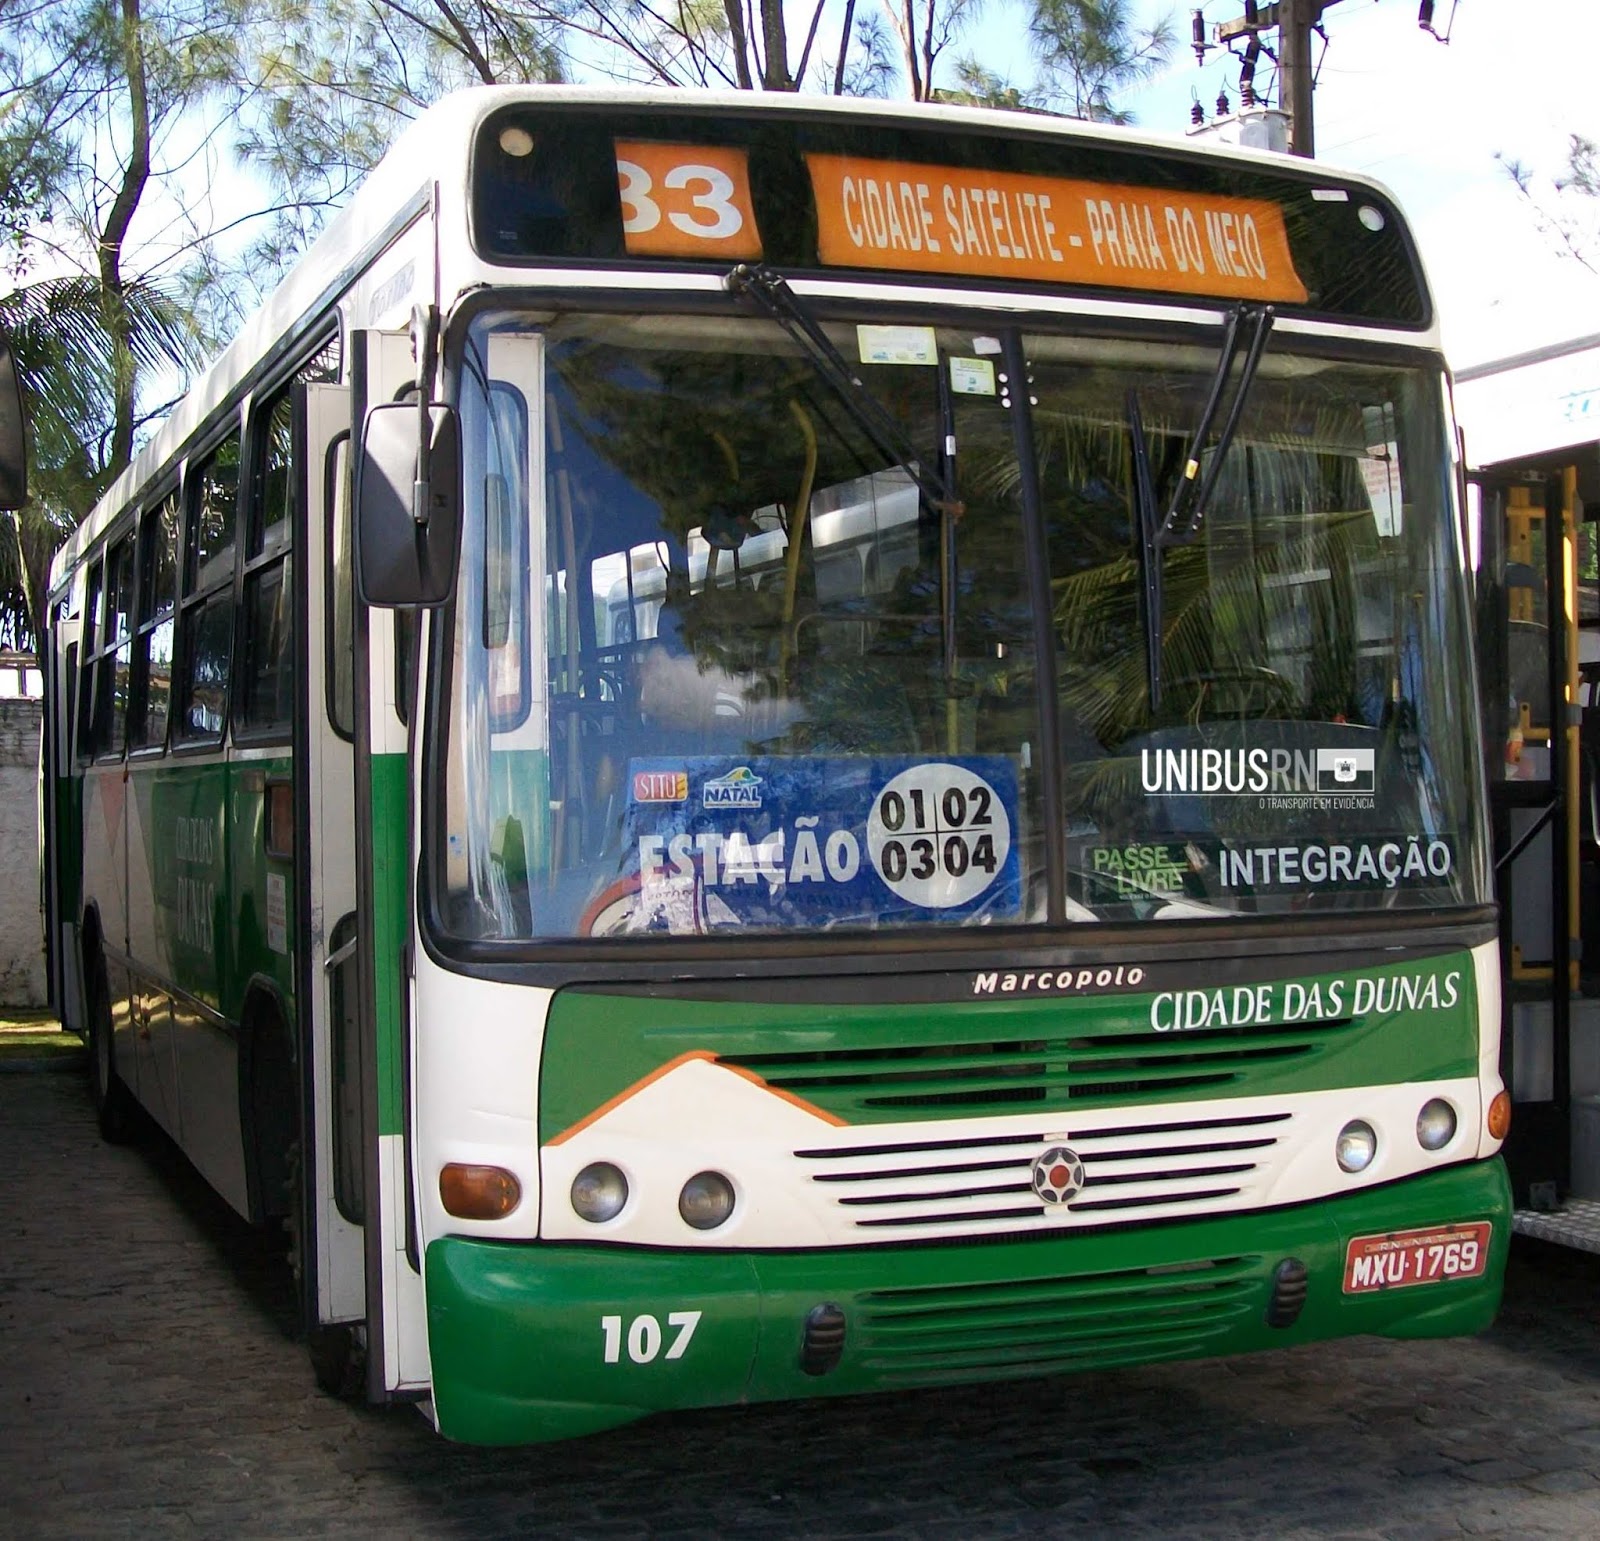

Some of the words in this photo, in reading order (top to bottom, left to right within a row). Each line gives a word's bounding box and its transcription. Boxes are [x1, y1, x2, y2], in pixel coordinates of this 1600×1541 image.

[842, 176, 941, 253] CIDADE
[1085, 199, 1168, 271] PRAIA
[1164, 206, 1206, 275] DO
[1204, 210, 1267, 280] MEIO
[704, 787, 760, 802] NATAL
[880, 789, 926, 832] 01
[942, 786, 993, 828] 02
[638, 815, 860, 906] ESTAÇÃO
[881, 838, 936, 883] 03
[943, 834, 998, 878] 04
[1093, 846, 1170, 871] PASSE
[1117, 869, 1184, 894] LIVRE
[1219, 835, 1452, 888] INTEGRAÇÃO
[973, 966, 1144, 994] Marcopolo
[1150, 986, 1273, 1032] CIDADE
[1282, 980, 1345, 1021] DAS
[1352, 971, 1461, 1015] DUNAS
[602, 1311, 702, 1364] 107
